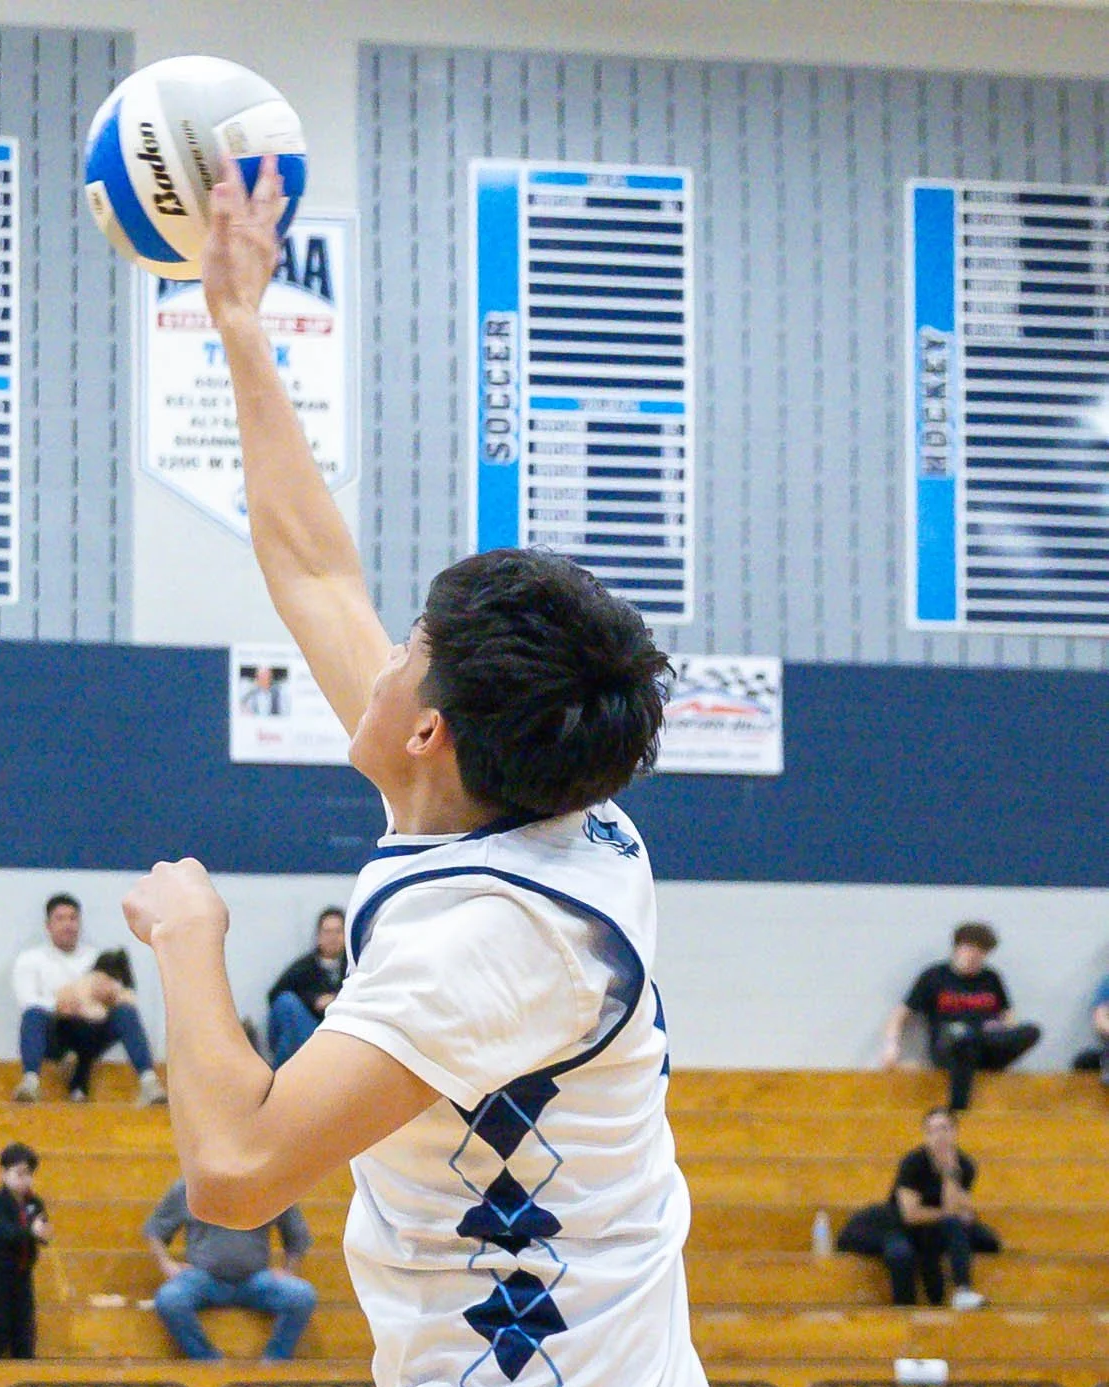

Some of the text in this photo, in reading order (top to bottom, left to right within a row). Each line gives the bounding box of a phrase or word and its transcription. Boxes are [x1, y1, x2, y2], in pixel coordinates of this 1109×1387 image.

[137, 121, 189, 216] Baden
[486, 320, 510, 459] SOCCER
[924, 333, 947, 476] HOCKEY
